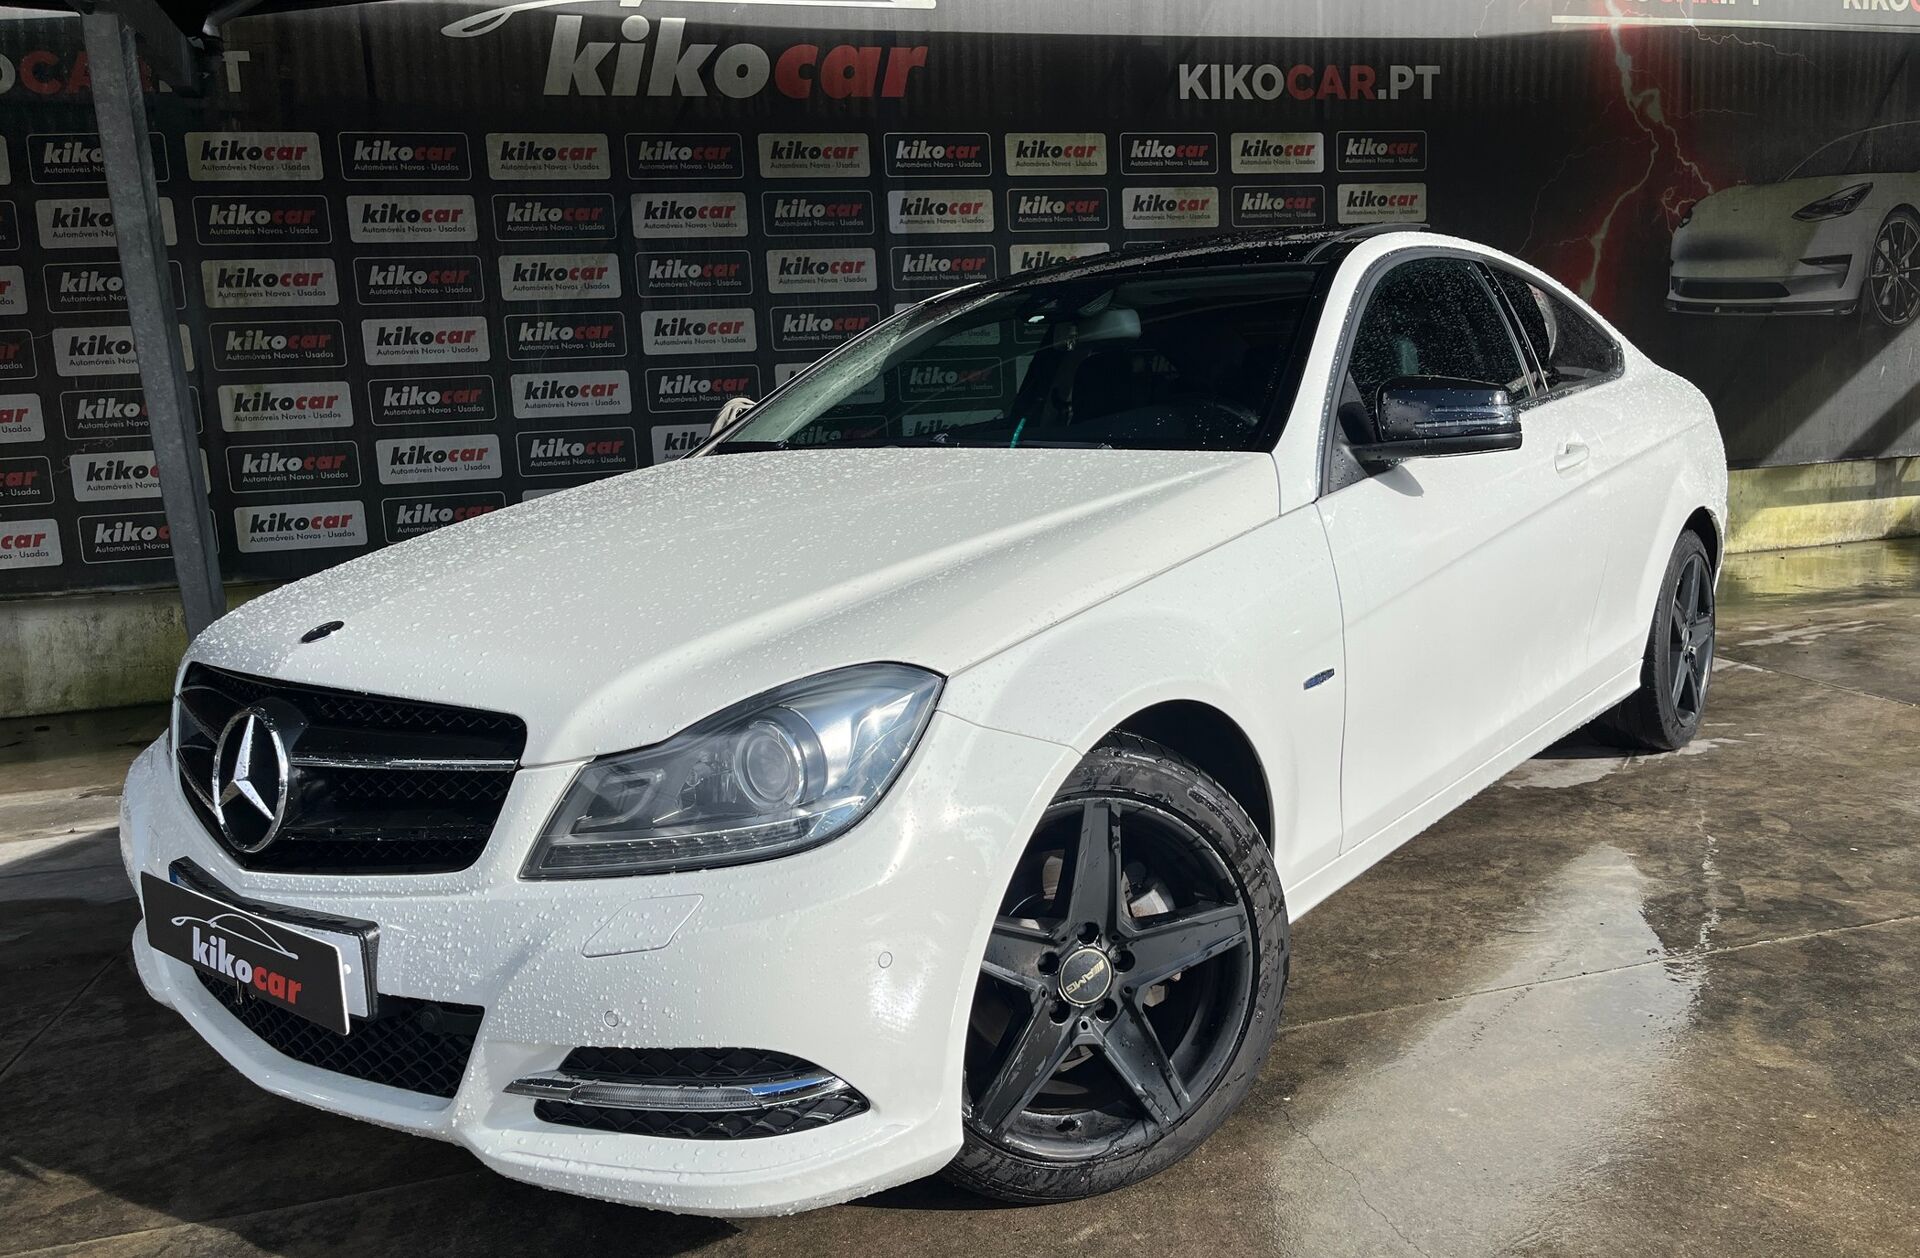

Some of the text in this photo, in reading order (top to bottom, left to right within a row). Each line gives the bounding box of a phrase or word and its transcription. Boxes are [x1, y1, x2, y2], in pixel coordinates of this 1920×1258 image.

[543, 14, 929, 98] kikocar
[1178, 63, 1441, 101] KIKOCAR.PT
[43, 142, 102, 164] kiko
[200, 140, 307, 161] kikocar
[354, 140, 456, 161] kikocar
[500, 141, 597, 161] kikocar
[639, 141, 731, 160] kikocar
[770, 140, 859, 160] kikocar
[896, 140, 980, 159] kikocar
[1016, 140, 1097, 158] kikocar
[1130, 140, 1208, 158] kikocar
[1240, 139, 1315, 157] kikocar
[1346, 138, 1417, 155] kikocar
[281, 162, 311, 171] Usados
[774, 199, 862, 218] kikocar
[899, 197, 983, 216] kikocar
[1018, 196, 1099, 214] kikocar
[1132, 194, 1209, 212] kikocar
[1241, 192, 1315, 210] kikocar
[1346, 190, 1418, 207] kikocar
[51, 206, 113, 228] kiko
[209, 204, 315, 225] kikocar
[362, 203, 463, 224] kikocar
[506, 202, 603, 222] kikocar
[644, 200, 736, 220] kikocar
[289, 225, 319, 234] Usados
[512, 262, 608, 282] kikocar
[649, 259, 740, 279] kikocar
[778, 256, 866, 276] kikocar
[902, 253, 986, 272] kikocar
[60, 271, 123, 293] kiko
[217, 267, 323, 289] kikocar
[369, 265, 469, 286] kikocar
[296, 288, 326, 297] Usados
[518, 321, 613, 342] kikocar
[654, 317, 744, 337] kikocar
[783, 313, 869, 333] kikocar
[68, 334, 131, 357] kiko
[226, 330, 330, 351] kikocar
[376, 326, 476, 347] kikocar
[304, 349, 334, 358] Usados
[0, 361, 24, 370] sados
[524, 380, 618, 401] kikocar
[659, 374, 749, 394] kikocar
[234, 391, 338, 413] kikocar
[383, 385, 482, 407] kikocar
[77, 397, 139, 420] kiko
[312, 410, 341, 419] Usados
[390, 445, 488, 466] kikocar
[530, 438, 624, 458] kikocar
[86, 460, 159, 482] kikoc
[242, 452, 345, 474] kikocar
[320, 470, 349, 479] Usados
[95, 521, 167, 544] kikoc
[250, 512, 352, 534] kikocar
[327, 529, 356, 538] Usados
[192, 926, 303, 1005] kikocar
